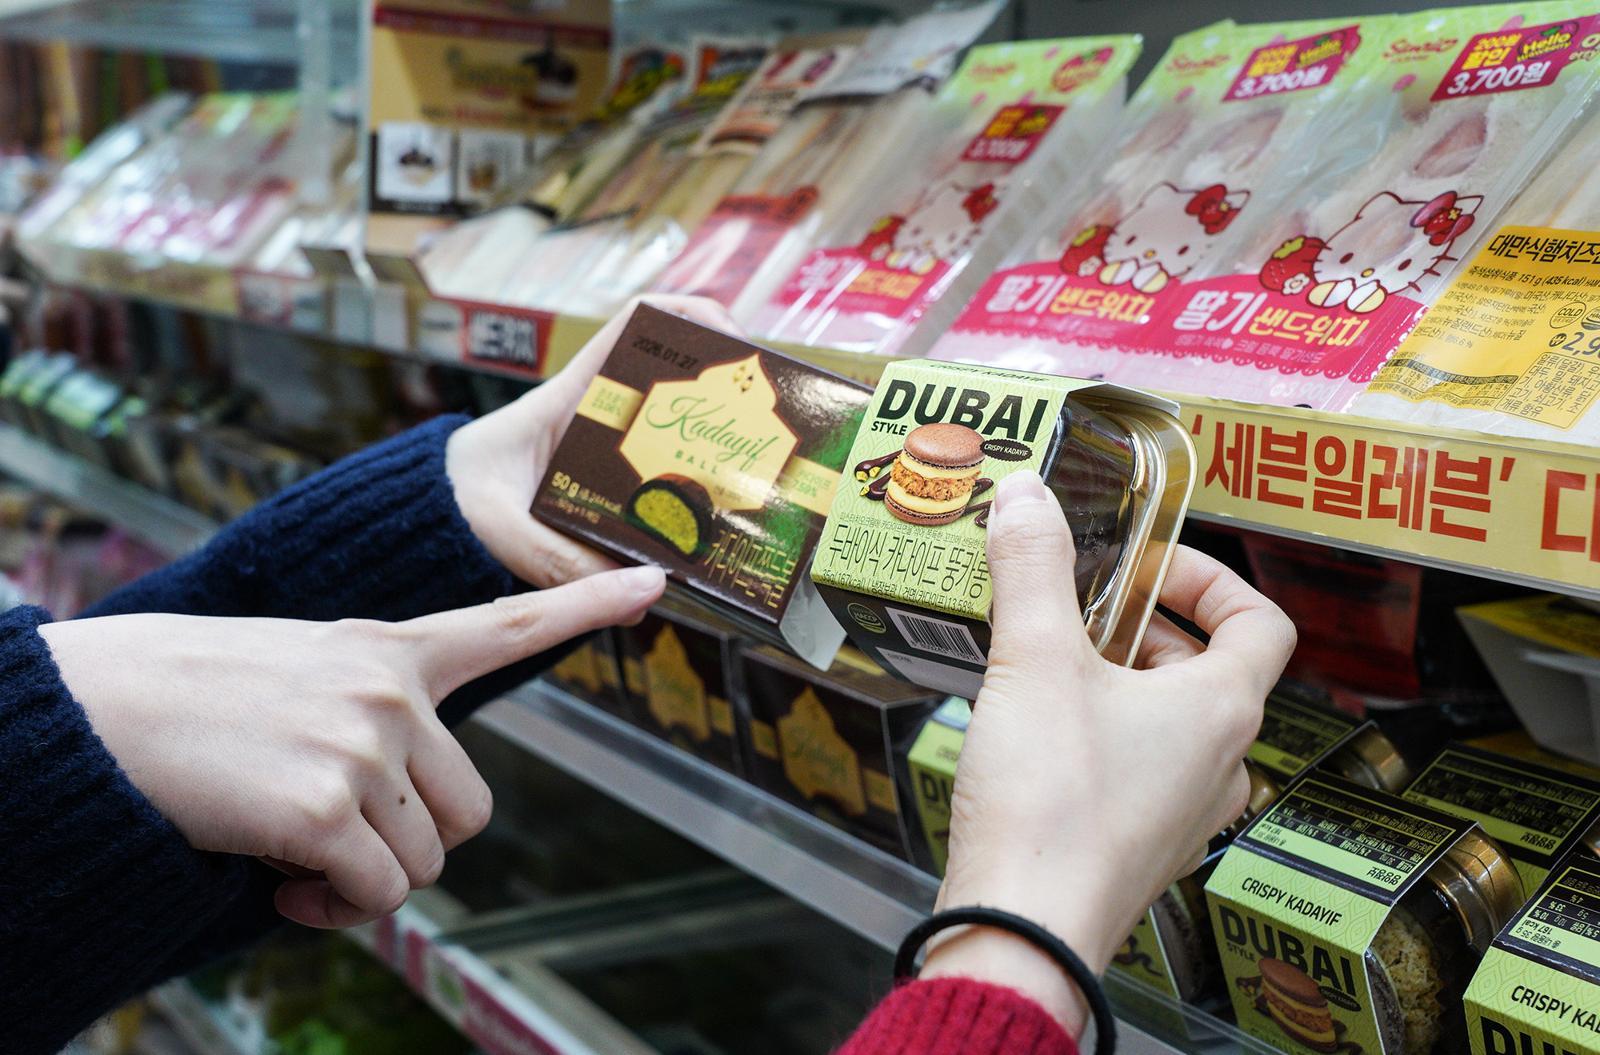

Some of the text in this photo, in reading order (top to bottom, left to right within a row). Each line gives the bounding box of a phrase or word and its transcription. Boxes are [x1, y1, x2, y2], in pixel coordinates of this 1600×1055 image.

[1462, 46, 1511, 70] 할인
[1447, 61, 1551, 95] 3,700원
[986, 274, 1068, 313] 딸기
[1518, 274, 1537, 284] 151
[1541, 276, 1562, 286] (435
[1561, 276, 1586, 287] kcal)
[1173, 290, 1268, 334] 딸기
[1557, 308, 1583, 317] COLD
[632, 336, 699, 371] 2026.01.27
[876, 379, 1049, 443] DUBAI
[645, 396, 779, 472] Kadayif
[871, 420, 908, 437] STYLE
[674, 449, 718, 476] BALL
[983, 443, 1029, 457] CRISPY KADAYIF
[551, 471, 571, 490] 50
[567, 482, 580, 498] g
[1192, 414, 1516, 543] '세븐일레븐'
[829, 524, 989, 599] 두바이식 카다이프 뚱카롱
[1366, 867, 1402, 886] 영양정보
[1241, 877, 1342, 926] CRISPY KADAYIF
[1520, 919, 1553, 936] 167 kcal
[1219, 904, 1356, 997] DUBAI
[1511, 985, 1572, 1019] CRISPY
